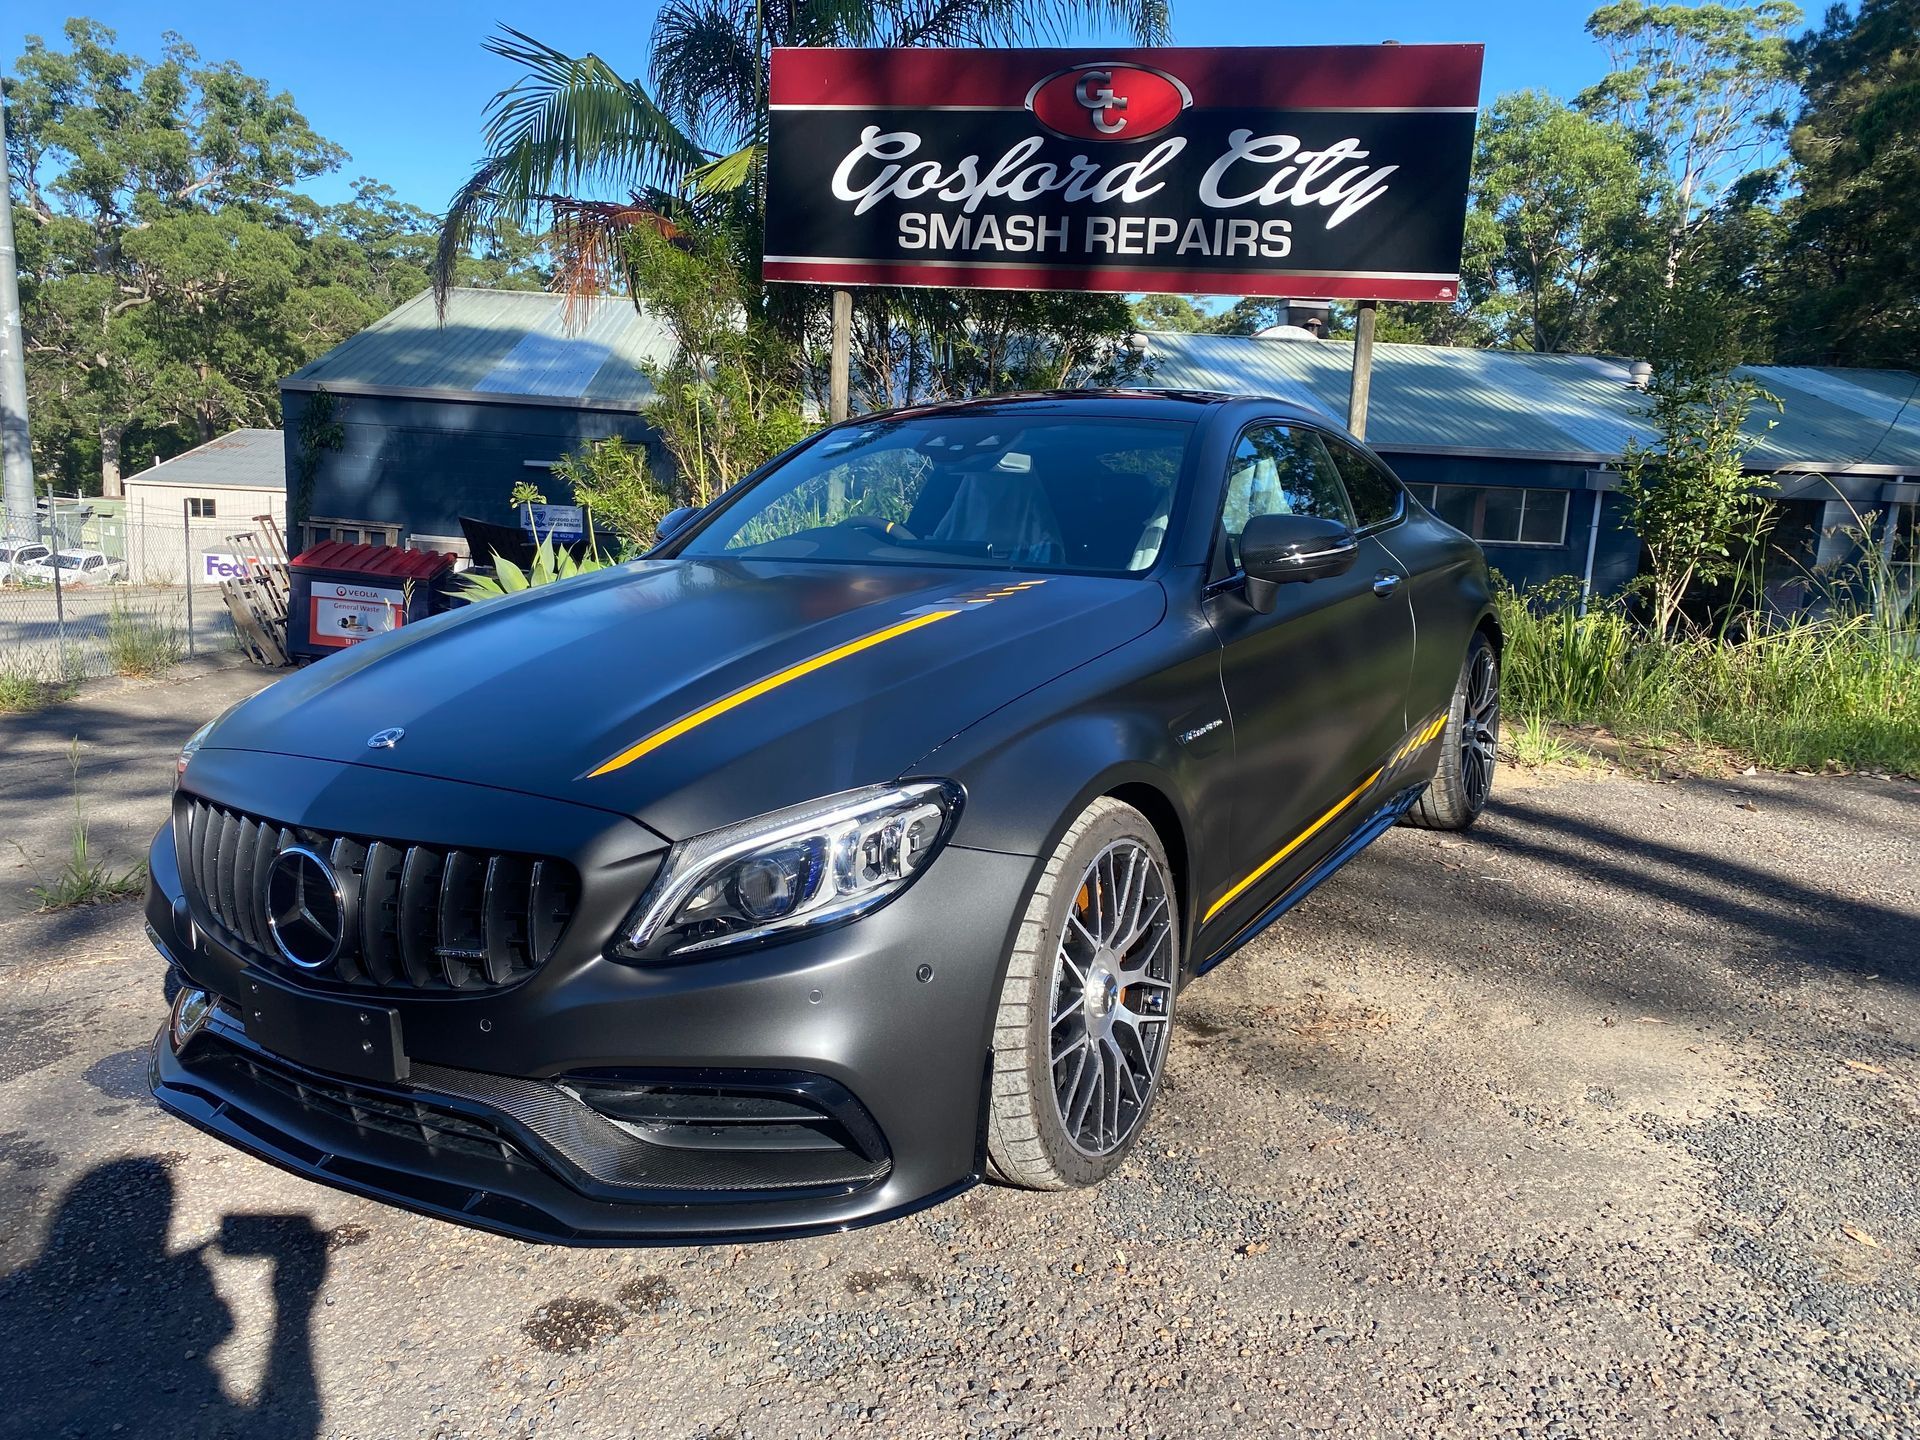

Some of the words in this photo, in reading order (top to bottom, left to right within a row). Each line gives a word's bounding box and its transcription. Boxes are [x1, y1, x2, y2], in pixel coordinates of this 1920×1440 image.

[831, 125, 1187, 216] Gosford
[1199, 128, 1400, 230] City
[898, 212, 1069, 253] SMASH
[1085, 216, 1293, 258] REPAIRS
[333, 602, 359, 610] General
[360, 605, 380, 613] Waste
[349, 589, 378, 598] VEOLIA
